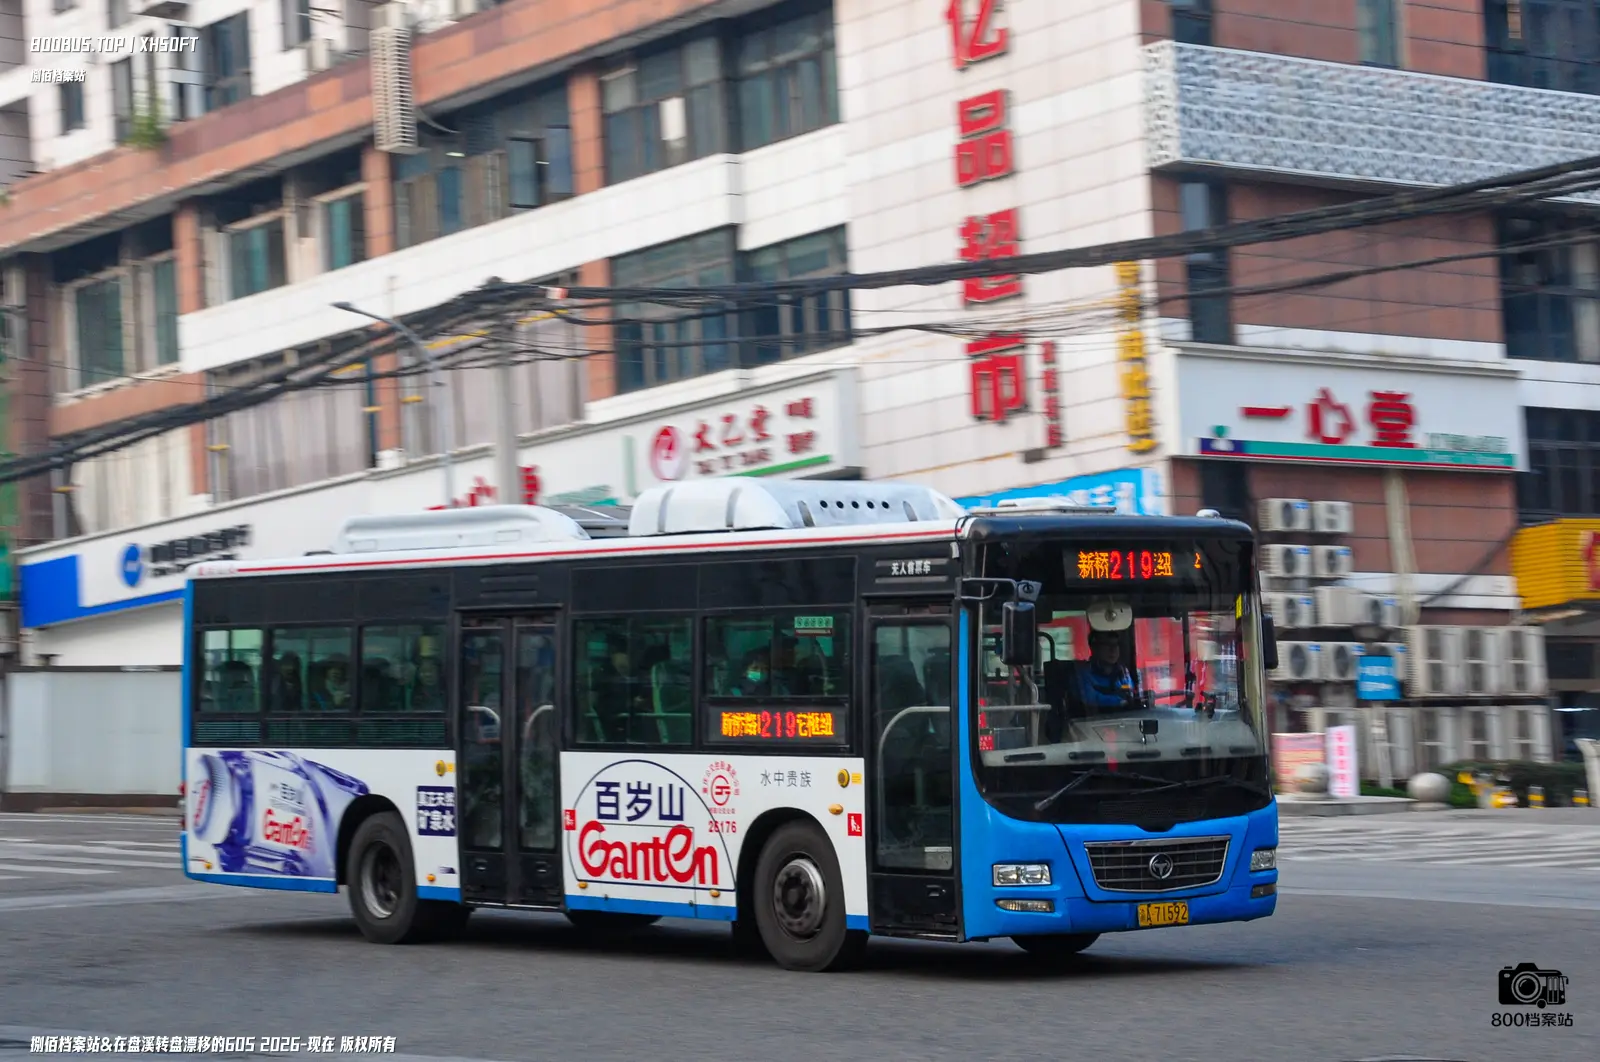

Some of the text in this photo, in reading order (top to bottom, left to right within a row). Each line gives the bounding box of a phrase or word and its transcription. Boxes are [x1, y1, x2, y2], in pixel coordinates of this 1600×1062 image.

[1239, 387, 1418, 448] 一心堂
[891, 560, 931, 576] 无人售票车
[759, 769, 812, 788] 水中贵族
[595, 780, 684, 821] 百岁山
